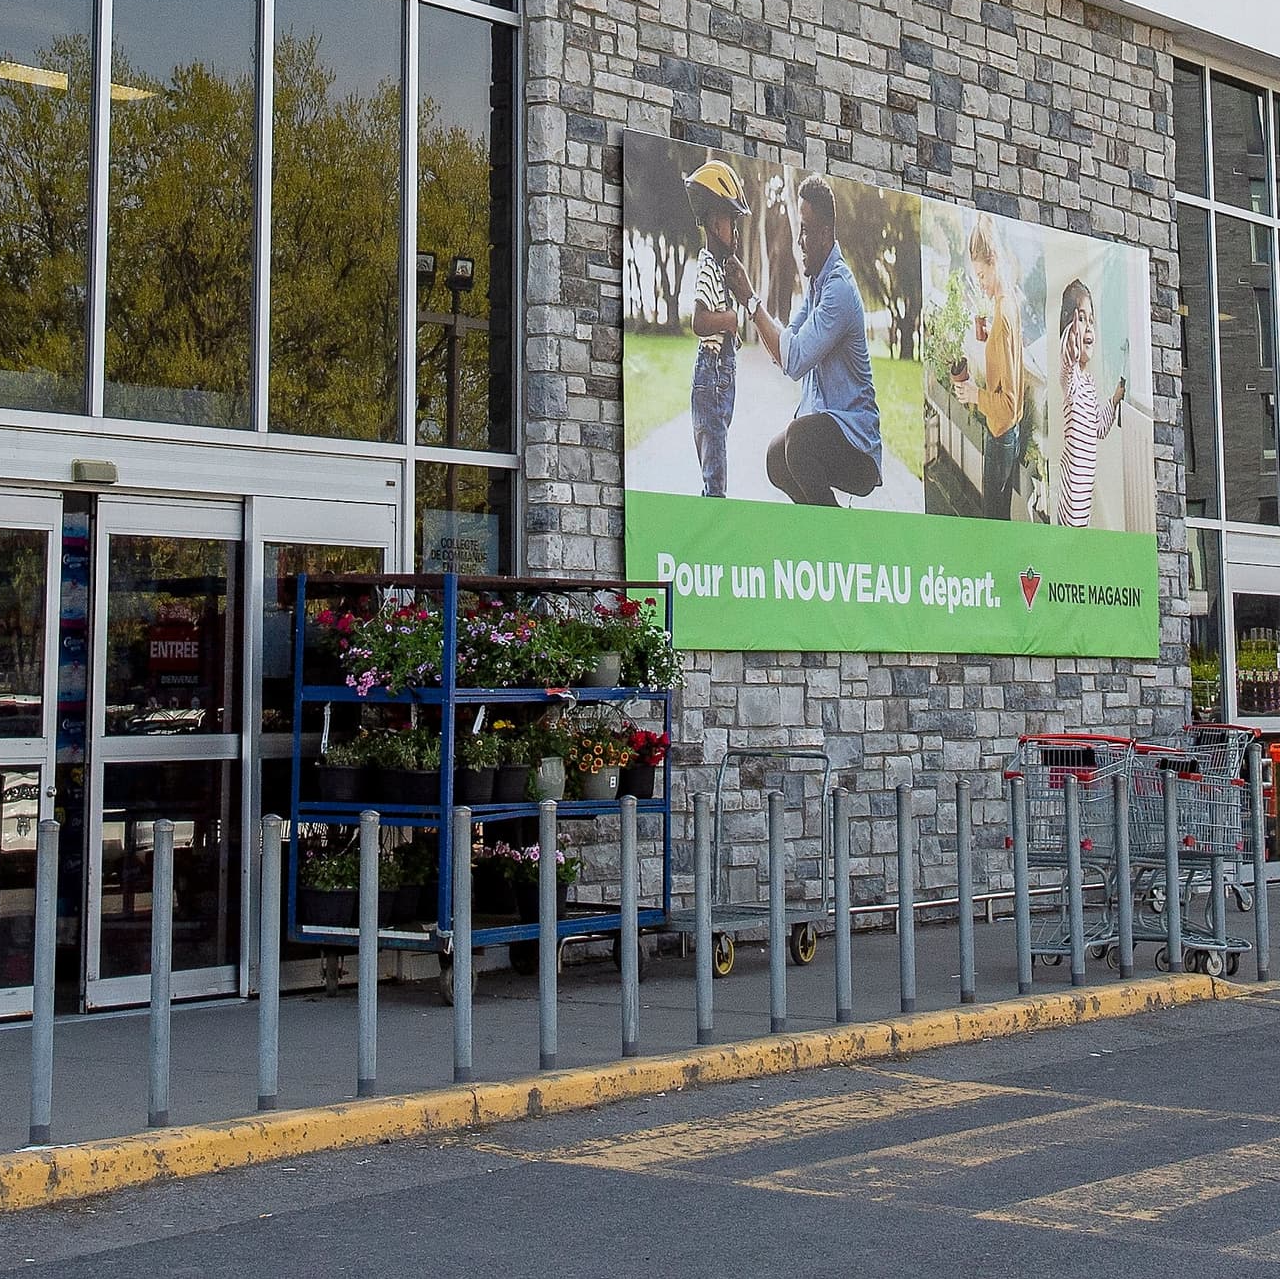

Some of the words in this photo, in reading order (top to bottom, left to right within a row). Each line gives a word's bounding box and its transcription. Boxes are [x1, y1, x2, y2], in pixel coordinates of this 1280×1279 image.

[440, 537, 481, 551] COLLECTE
[430, 549, 441, 561] DE
[441, 550, 488, 564] COMMANDE
[657, 552, 724, 597] Pour
[731, 565, 766, 599] un
[773, 559, 912, 605] NOUVEAU
[919, 564, 1002, 614] départ.
[1048, 582, 1086, 604] NOTRE
[1088, 584, 1141, 607] MAGASIN
[150, 637, 199, 659] ENTRÉE
